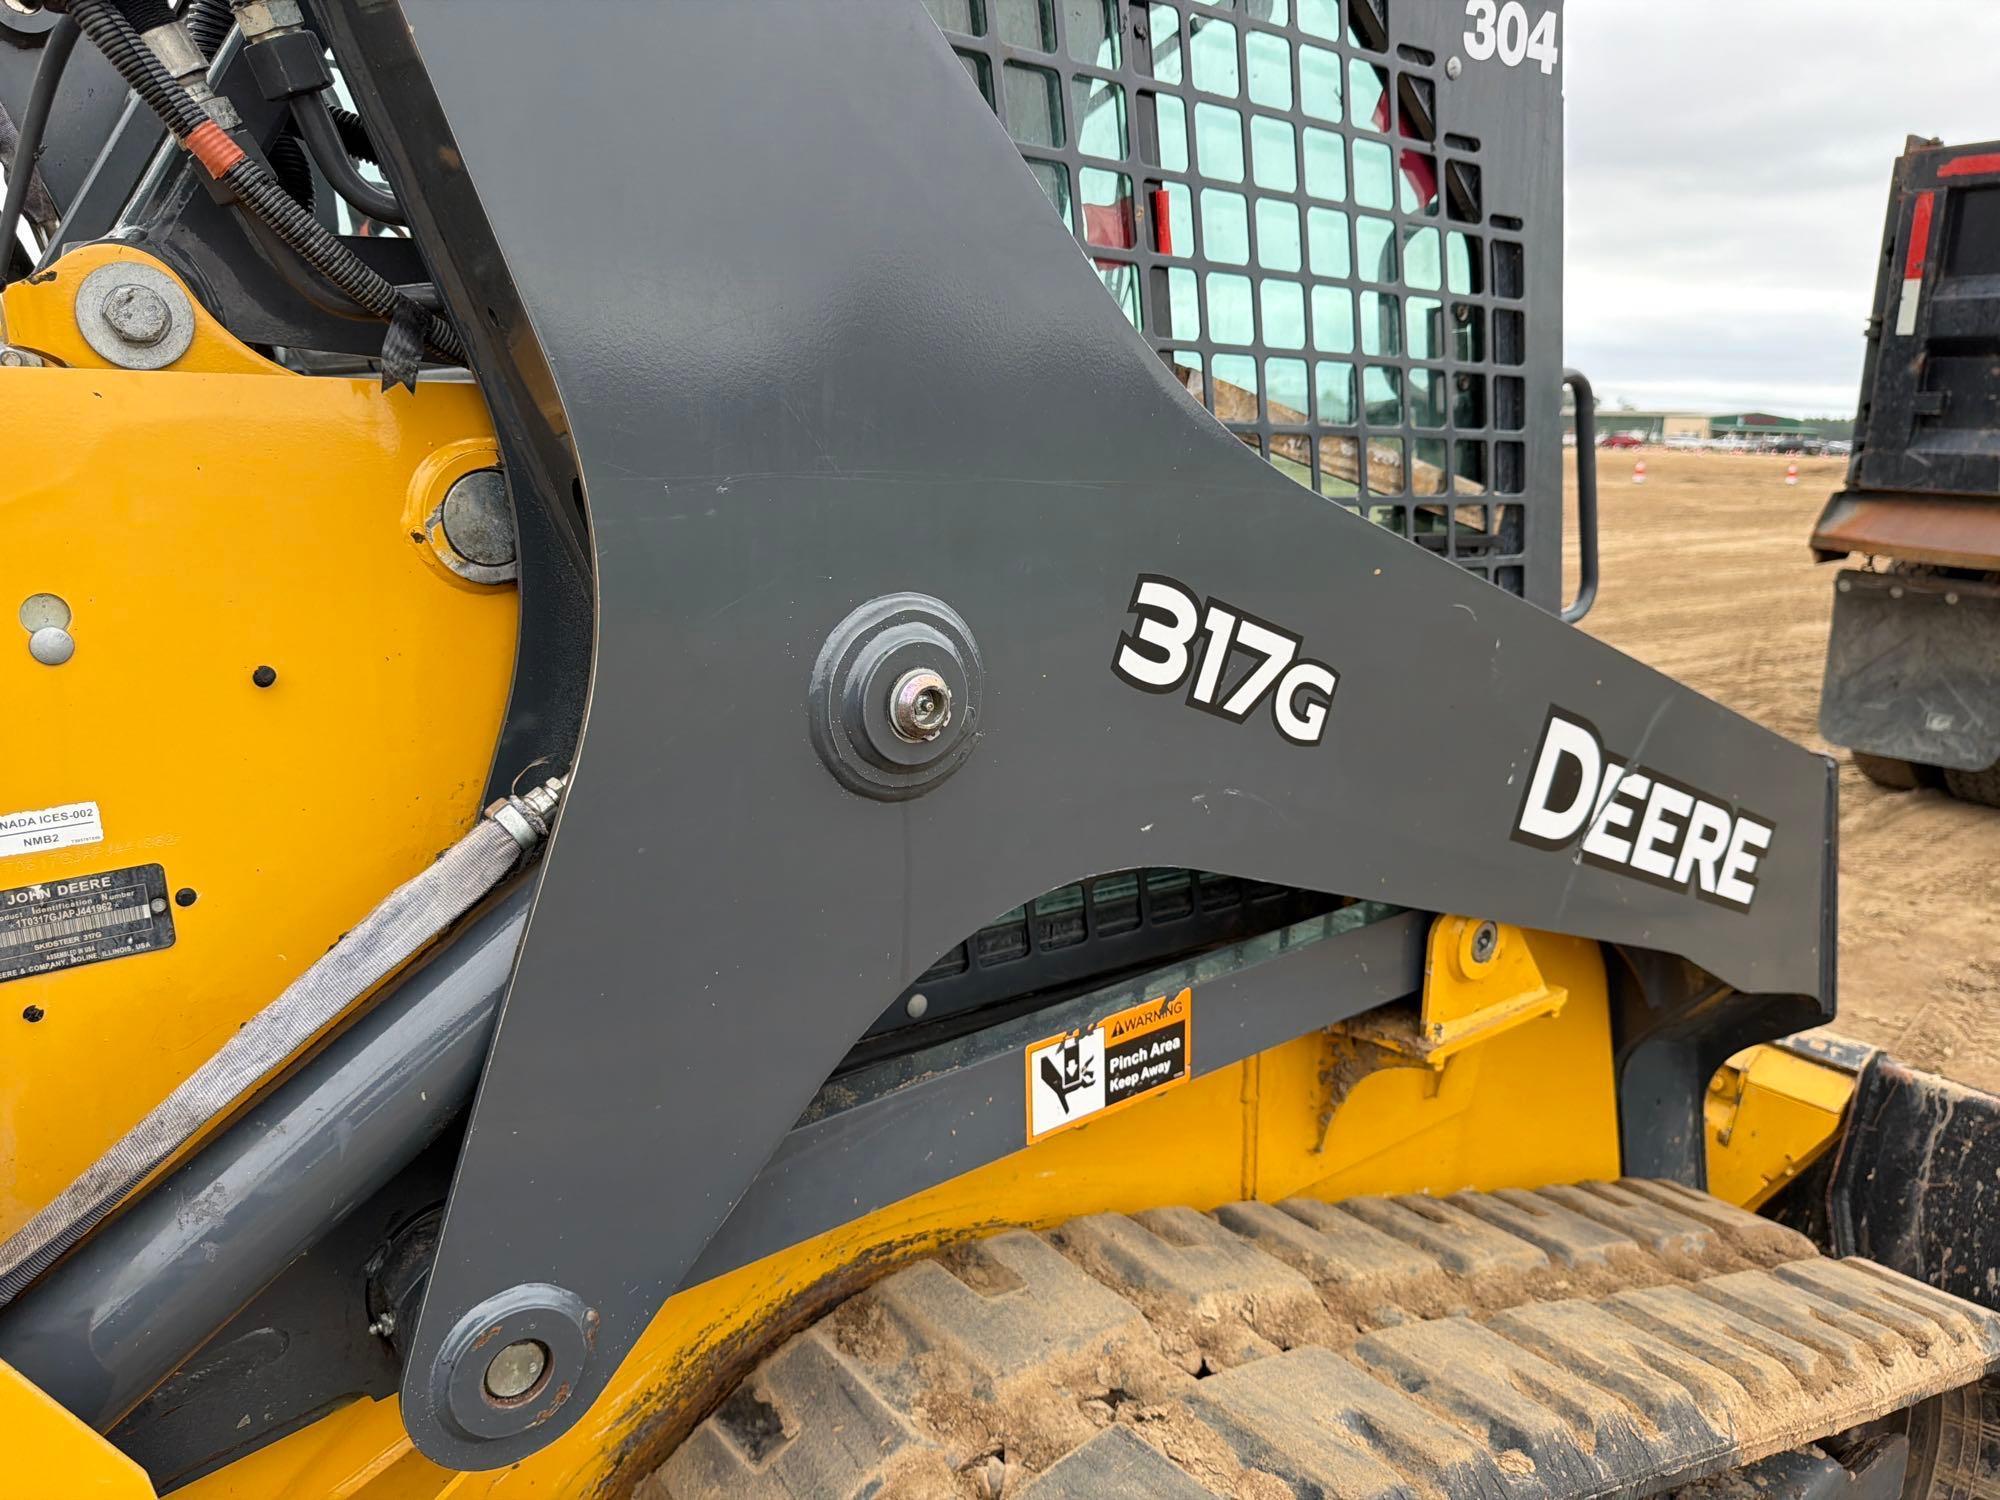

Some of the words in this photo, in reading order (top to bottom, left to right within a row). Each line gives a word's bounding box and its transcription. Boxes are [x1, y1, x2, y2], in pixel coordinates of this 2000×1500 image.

[1463, 0, 1558, 75] 304
[1115, 578, 1338, 743] 317G
[39, 808, 93, 824] ICES-002
[1515, 712, 1774, 908] DEERE
[23, 833, 59, 847] NMB2
[7, 887, 51, 905] JOHN
[57, 876, 112, 896] DEERE
[31, 897, 93, 914] Identification
[100, 891, 135, 901] Number
[33, 936, 80, 951] SKIDSTEER
[82, 931, 102, 941] 317G
[135, 942, 151, 950] USA
[1109, 1048, 1148, 1073] Pinch
[1149, 1037, 1181, 1058] Area
[1109, 1072, 1140, 1093] Keep
[1140, 1060, 1171, 1081] Away
